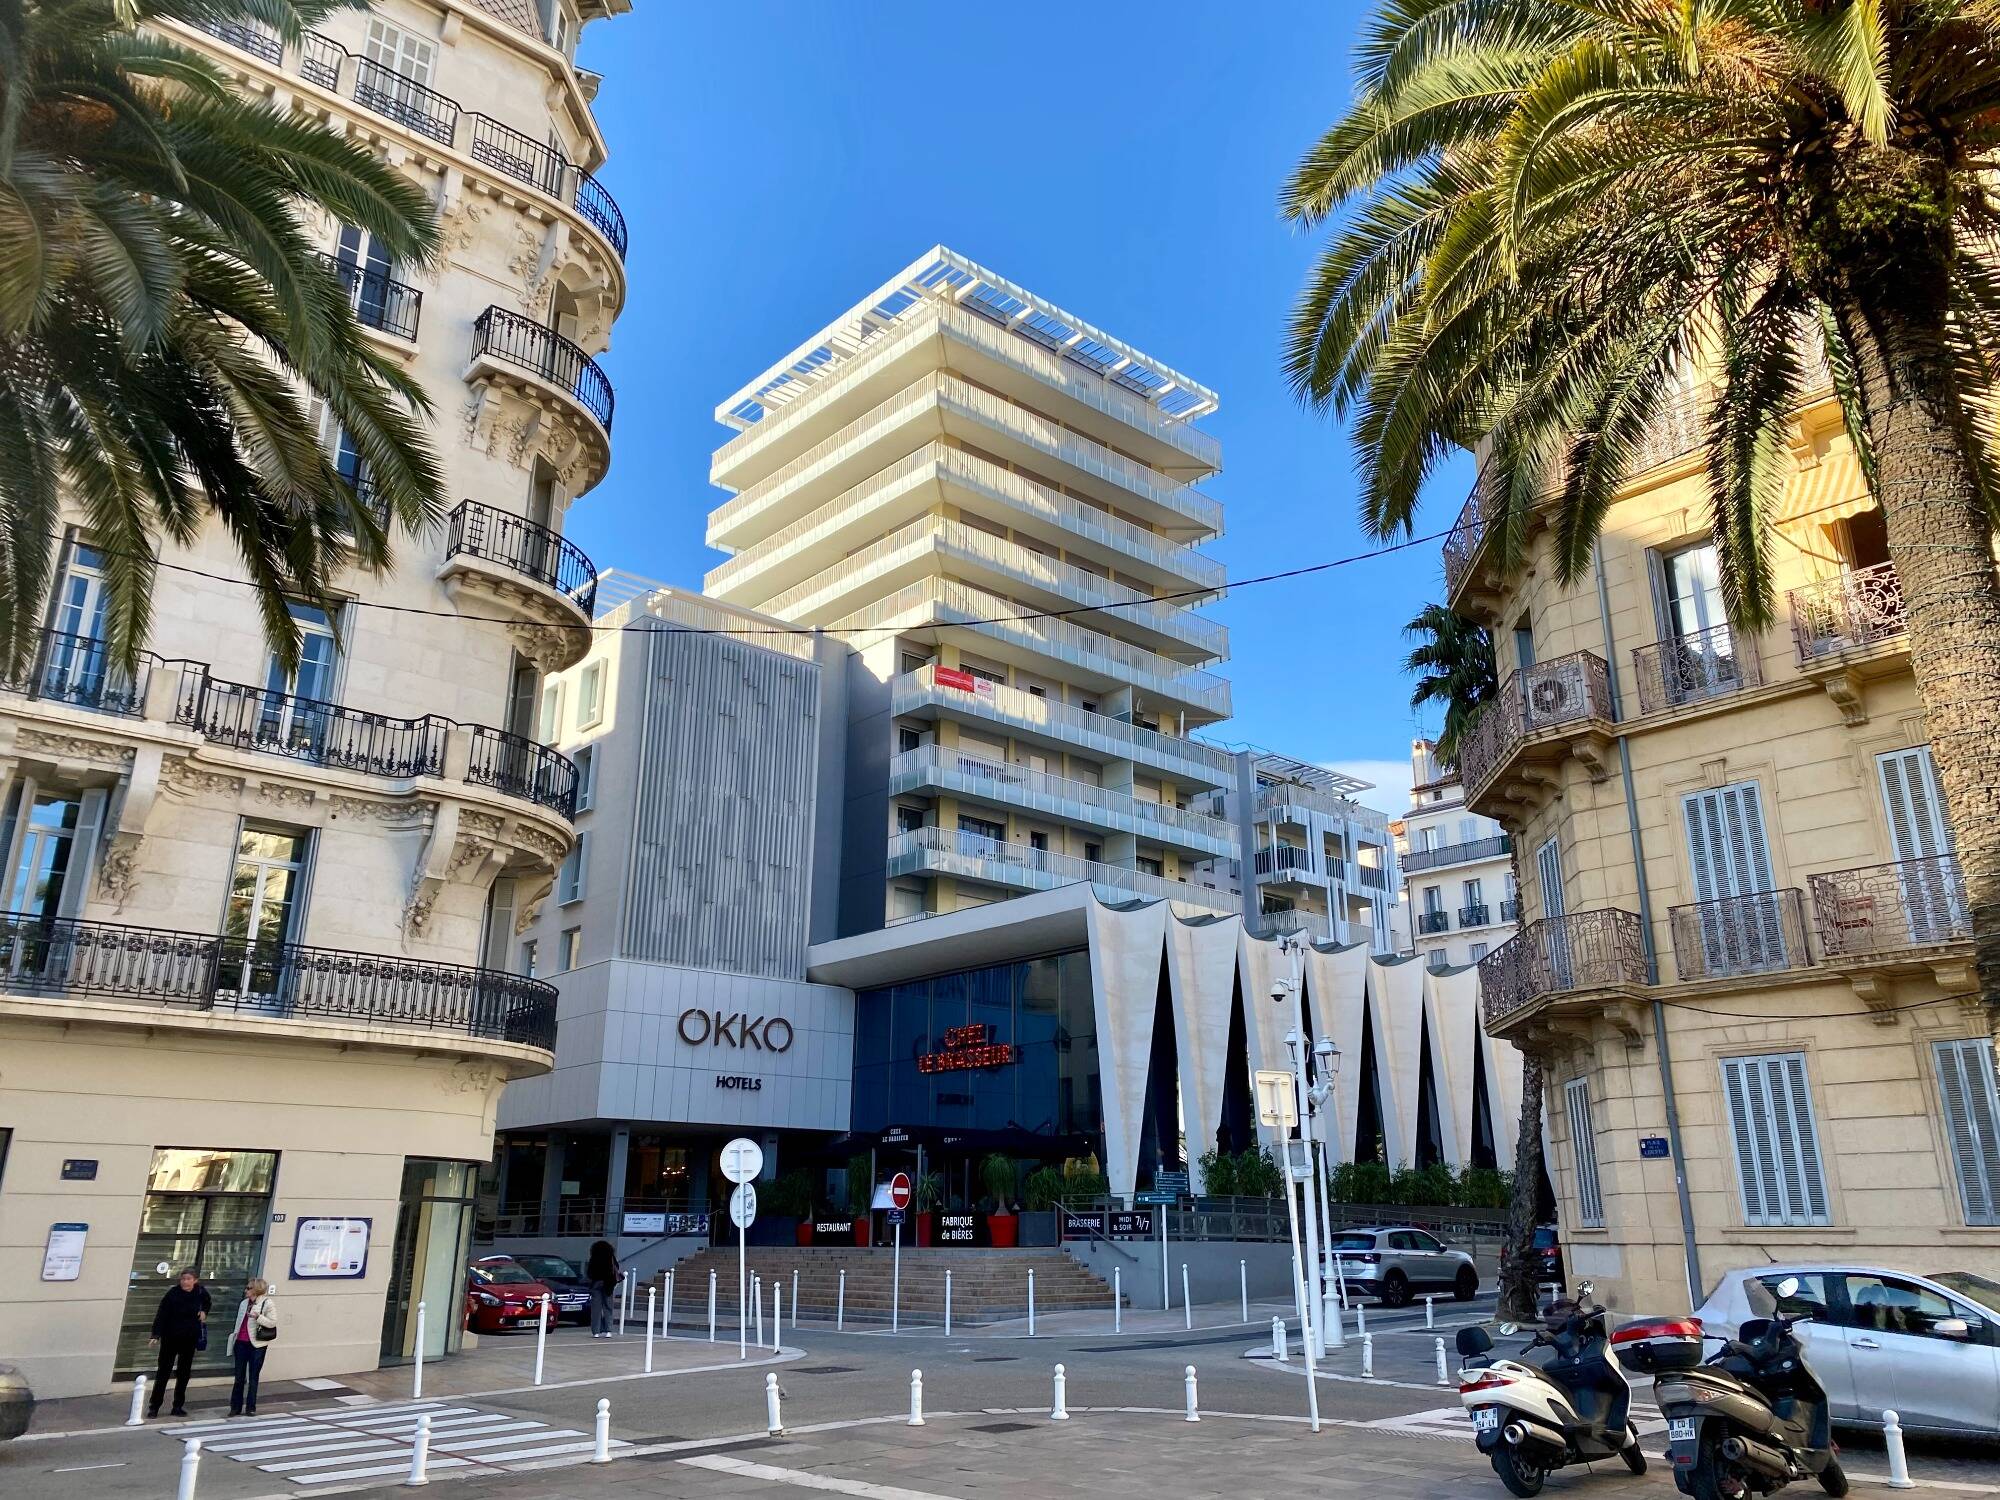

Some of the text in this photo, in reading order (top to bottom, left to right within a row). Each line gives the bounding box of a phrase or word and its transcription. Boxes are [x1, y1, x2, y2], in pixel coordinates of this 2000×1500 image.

[678, 1008, 793, 1053] OKKO
[937, 1043, 1012, 1070] BRASSEUR
[716, 1075, 762, 1091] HOTELS
[274, 1214, 284, 1222] 103
[942, 1216, 973, 1228] FABRIQUE
[1068, 1218, 1101, 1228] BRASSERIE
[816, 1222, 852, 1232] RESTAURANT
[941, 1227, 973, 1240] de BIÈRES
